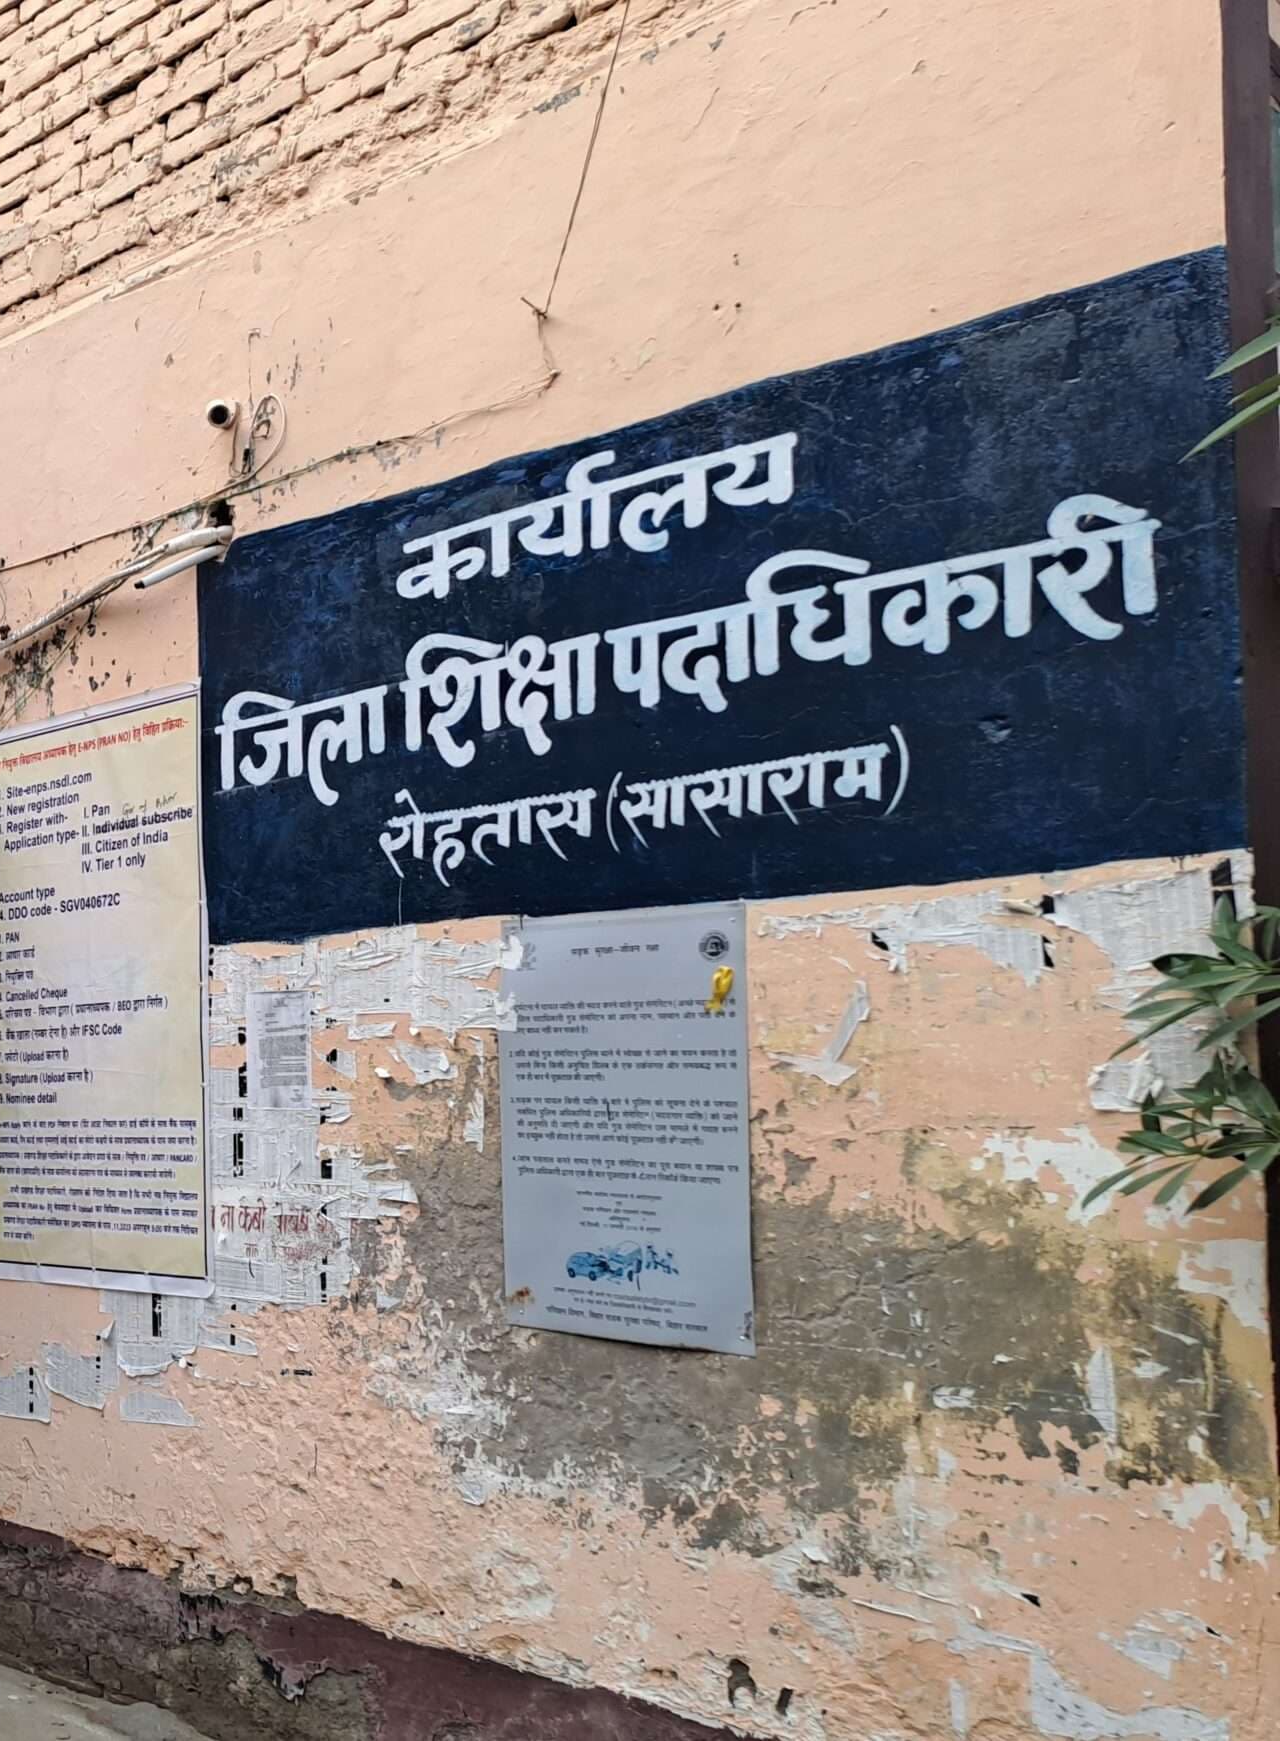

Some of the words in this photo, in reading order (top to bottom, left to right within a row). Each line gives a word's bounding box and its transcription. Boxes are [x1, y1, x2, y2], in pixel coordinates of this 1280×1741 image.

[396, 430, 798, 600] कार्यालय
[214, 690, 387, 806] जिला
[400, 631, 600, 768] शिक्षा
[611, 492, 1162, 713] पदाधिकारी
[6, 771, 93, 801] Site-enps.nsdl.com
[6, 802, 25, 817] New
[27, 792, 80, 816] registration
[91, 803, 111, 819] Pan
[378, 786, 593, 888] रोहतास
[605, 723, 910, 855] (सासाराम)
[6, 814, 44, 837] Register
[45, 812, 69, 827] with-
[92, 814, 139, 836] Individual
[141, 807, 193, 827] subscribe
[3, 830, 54, 854] Application
[56, 825, 81, 845] type-
[81, 842, 93, 856] III.
[95, 837, 129, 854] Citizen
[130, 834, 141, 849] of
[143, 829, 169, 846] India
[81, 859, 93, 874] IV.
[95, 857, 115, 872] Tier
[125, 851, 147, 869] only
[35, 885, 56, 903] type
[8, 906, 29, 921] DDO
[30, 903, 52, 919] code
[60, 892, 121, 913] SGV040672C
[5, 931, 20, 944] PAN
[22, 945, 36, 959] कार्ड
[5, 987, 40, 1003] Cancelled
[40, 985, 68, 1002] Cheque
[117, 1000, 132, 1012] BEO
[81, 1023, 101, 1037] IFSC
[101, 1022, 123, 1037] Code
[5, 1070, 38, 1087] Signature
[6, 1093, 36, 1105] Nominee
[37, 1090, 58, 1104] detail
